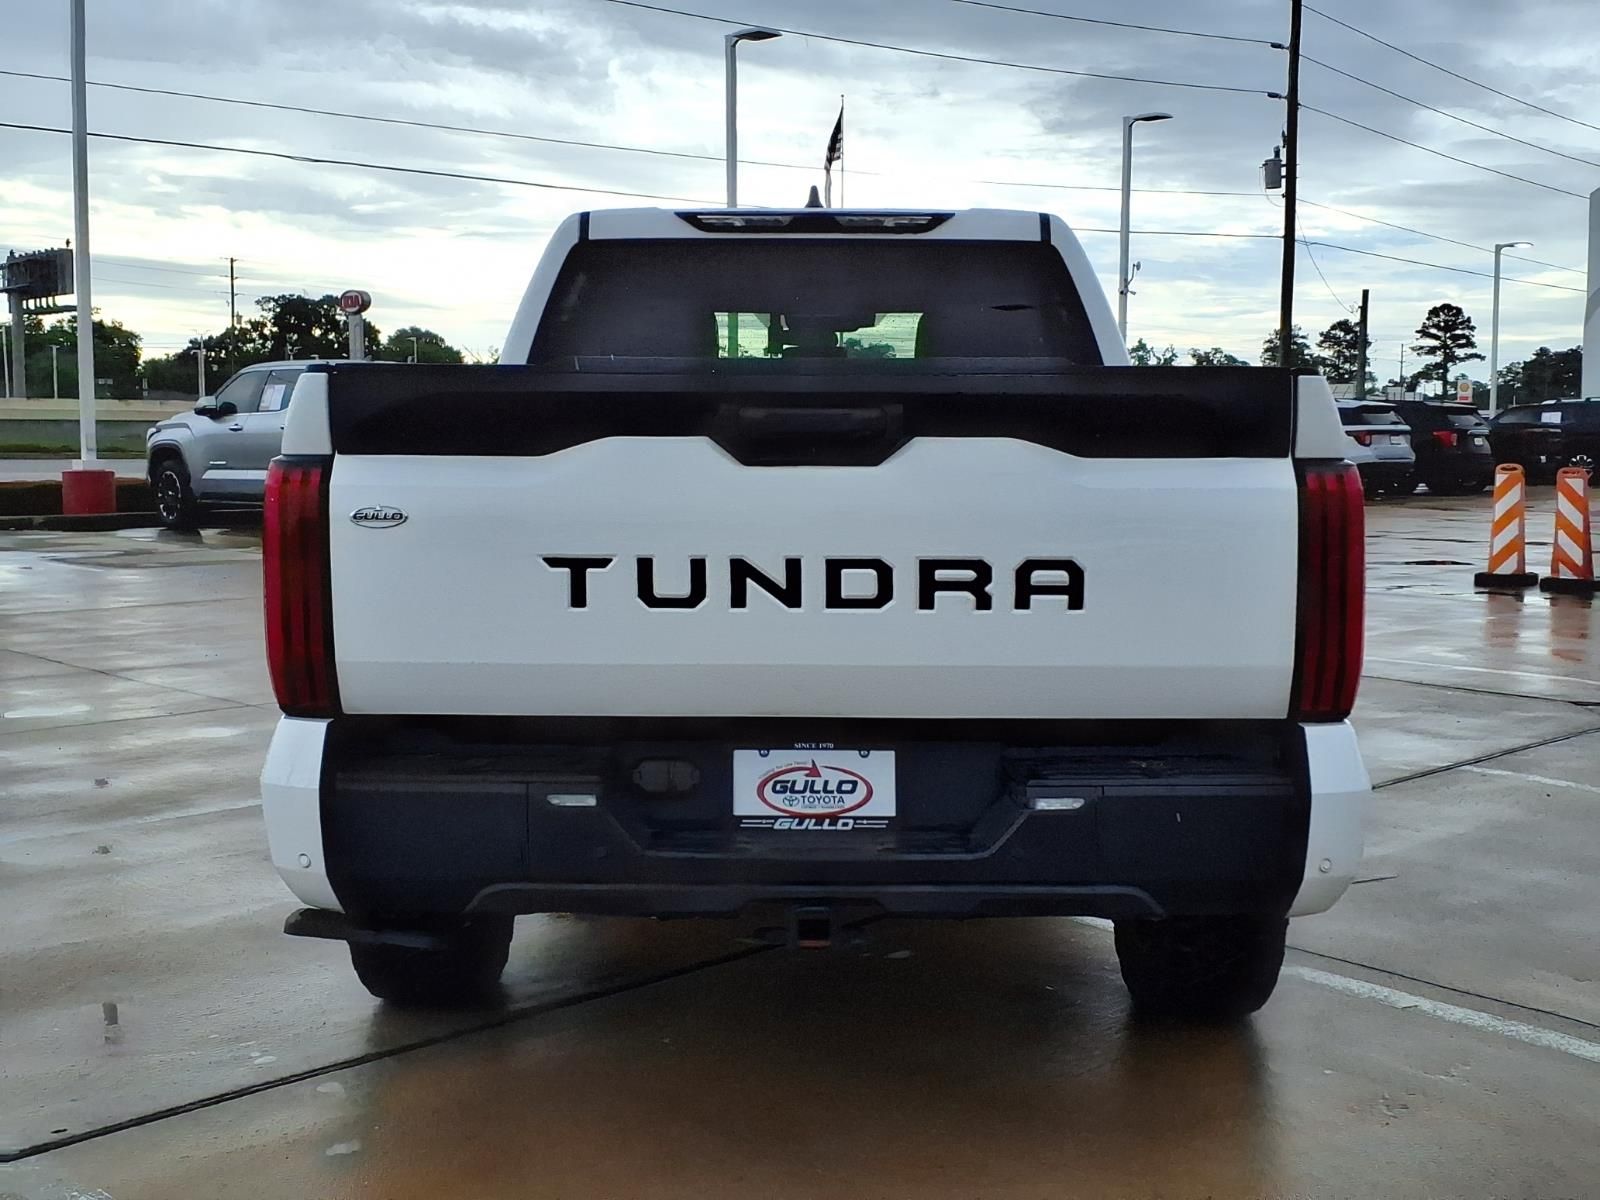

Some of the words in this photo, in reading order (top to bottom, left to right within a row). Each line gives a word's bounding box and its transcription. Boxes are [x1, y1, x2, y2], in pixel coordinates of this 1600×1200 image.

[352, 512, 404, 521] GULLO
[541, 556, 1086, 612] TUNDRA
[771, 779, 859, 795] GULLO
[801, 796, 845, 805] TOYOTA
[773, 818, 855, 830] GULLO
